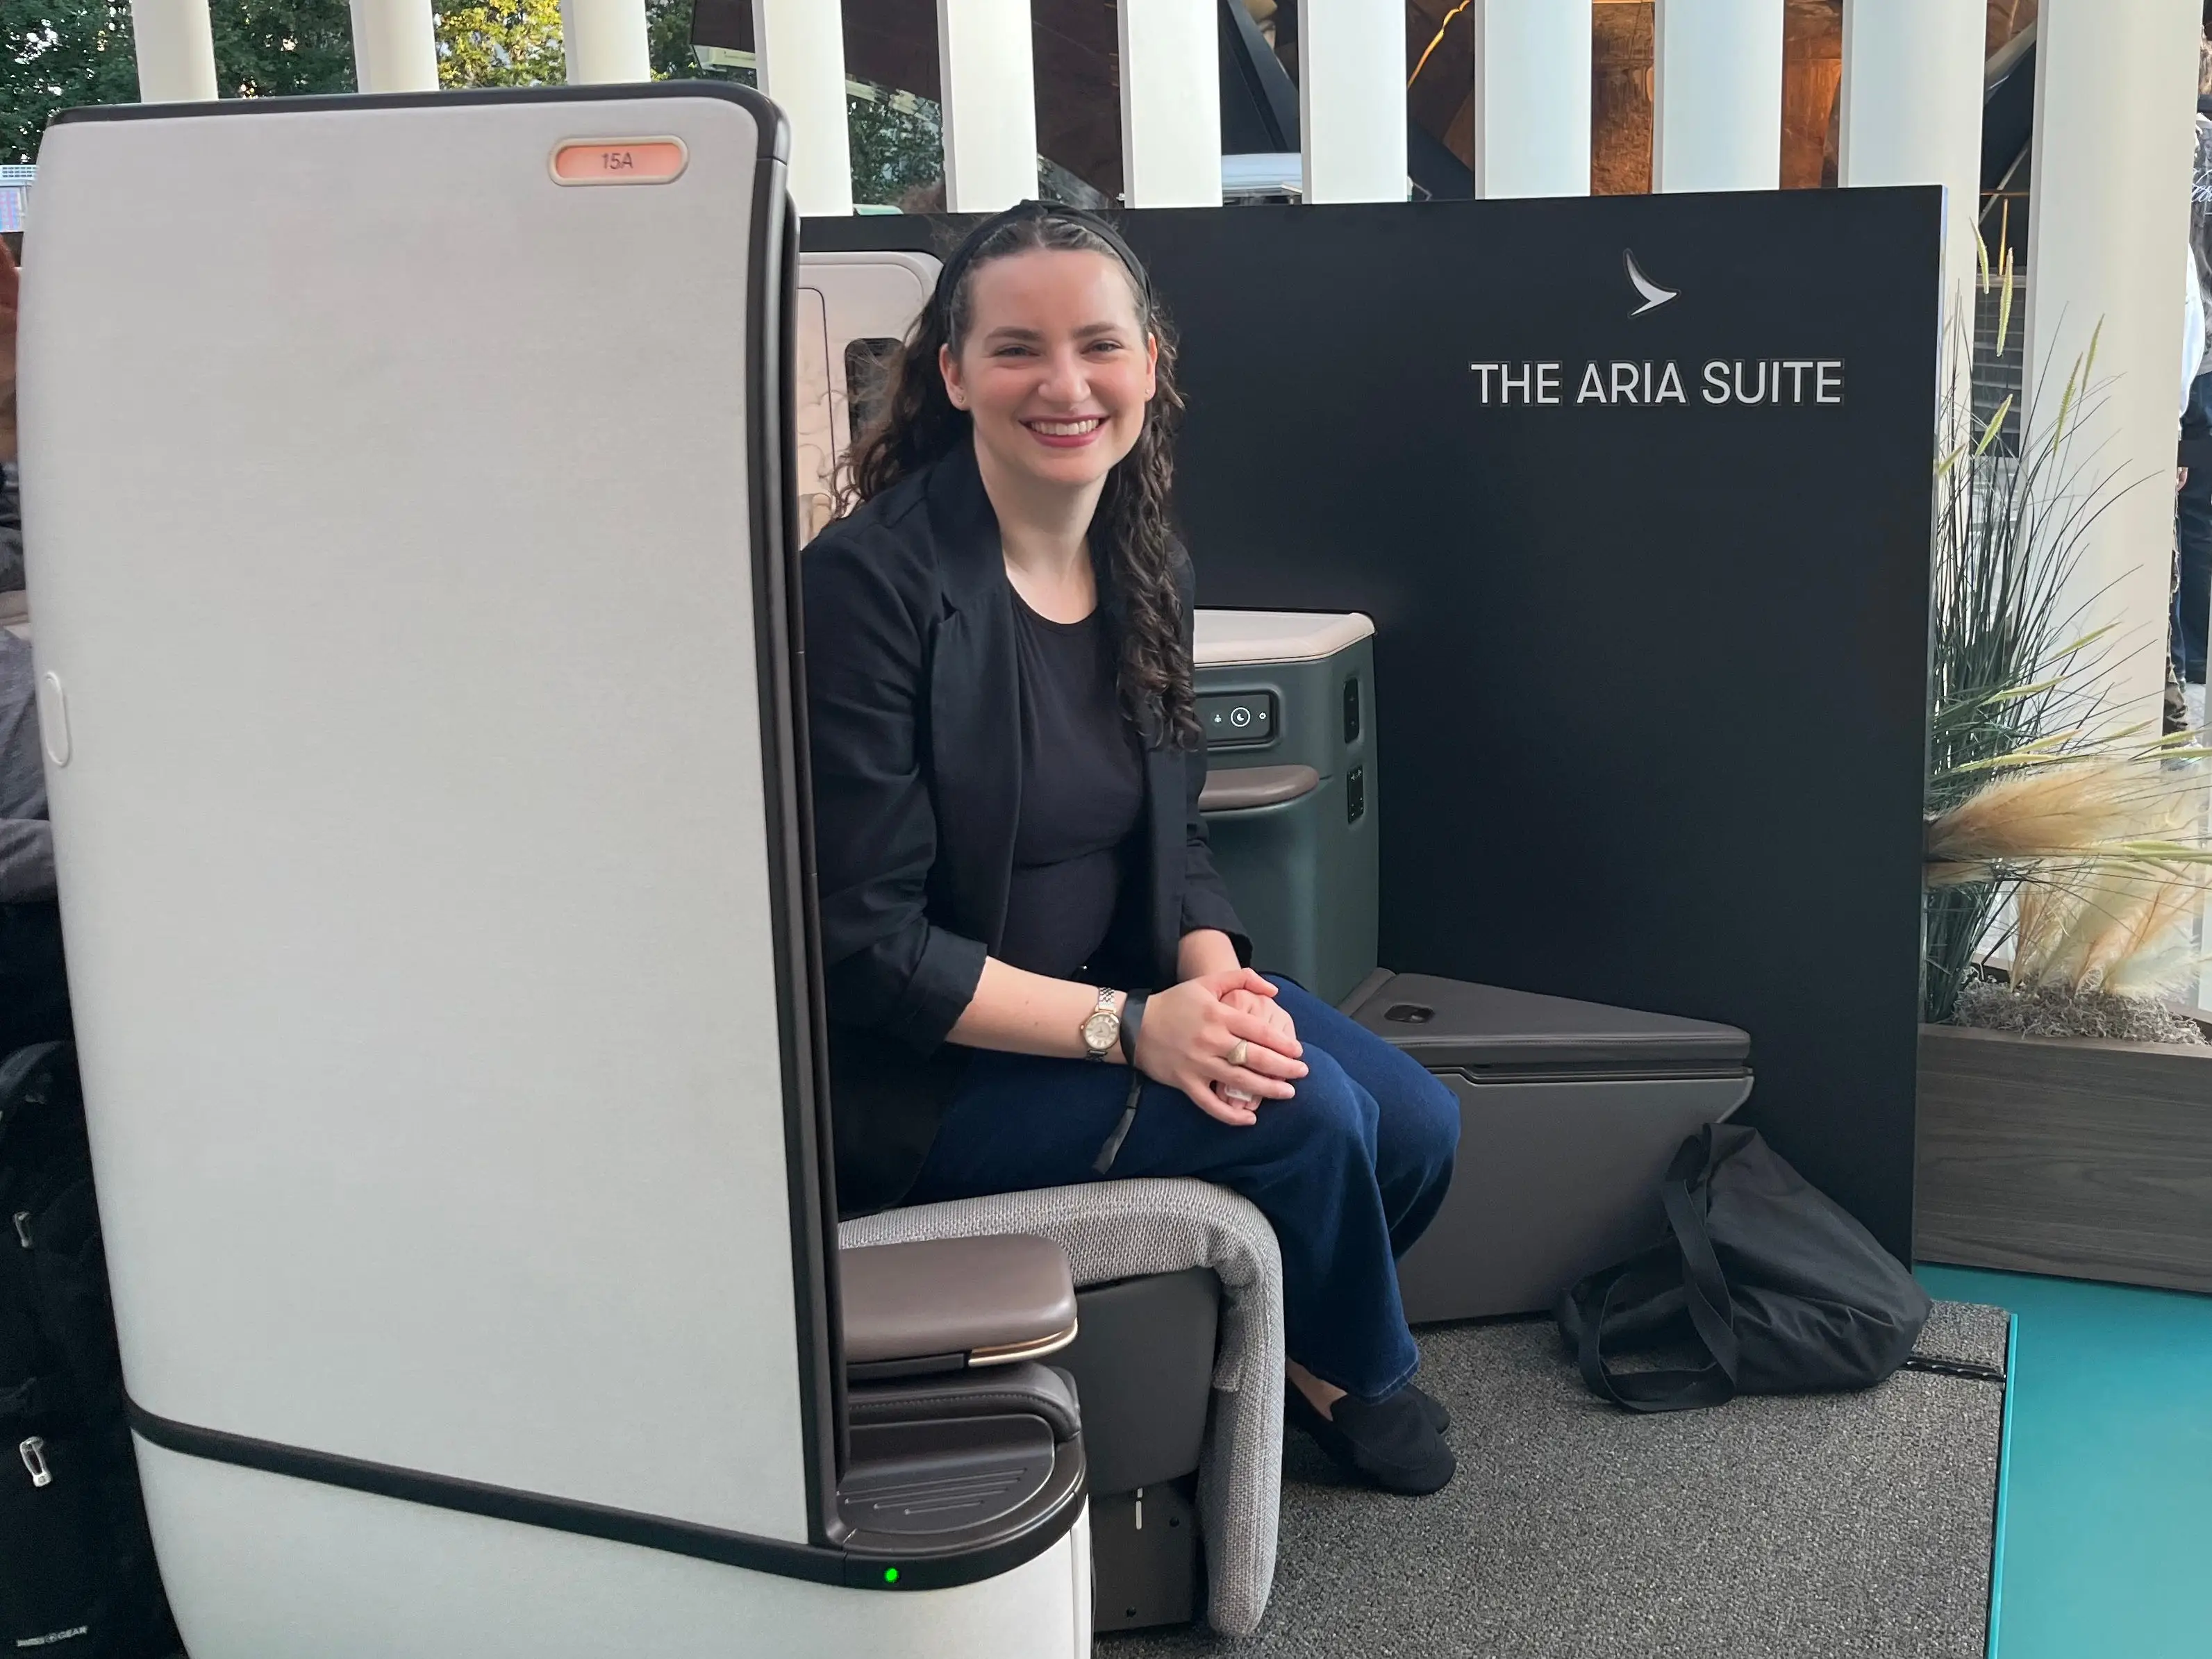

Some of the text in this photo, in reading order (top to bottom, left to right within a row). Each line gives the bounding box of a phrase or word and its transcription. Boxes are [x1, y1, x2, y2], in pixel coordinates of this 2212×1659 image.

[601, 152, 633, 169] 15A
[1470, 360, 1842, 404] THE ARIA SUITE
